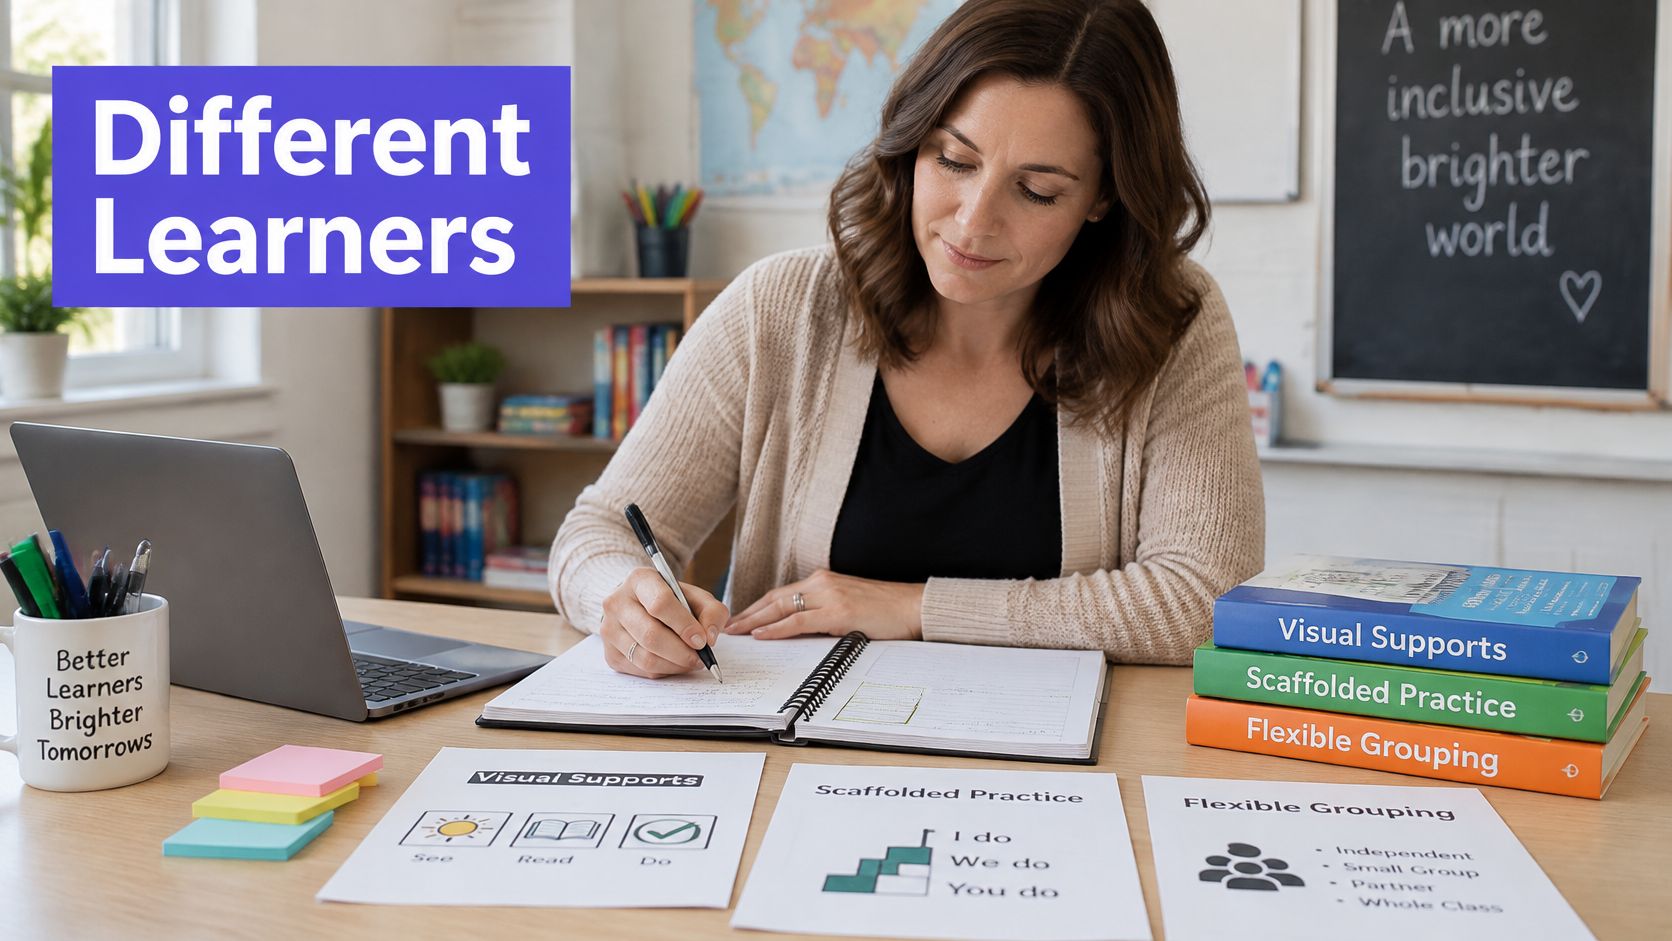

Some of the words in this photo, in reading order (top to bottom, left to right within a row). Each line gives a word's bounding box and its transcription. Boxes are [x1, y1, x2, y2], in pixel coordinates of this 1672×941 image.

[1381, 1, 1415, 54] A
[1439, 9, 1548, 49] more
[1387, 64, 1580, 121] inclusive
[1402, 132, 1590, 212] brighter
[1425, 200, 1555, 258] world
[1278, 617, 1362, 647] Visual
[1371, 621, 1508, 661] Supports
[57, 649, 130, 672] Better
[47, 675, 143, 699] Learners
[1246, 666, 1390, 705] Scaffolded
[1400, 683, 1517, 718] Practice
[50, 704, 143, 737] Brighter
[37, 733, 153, 761] Tomorrows
[1246, 717, 1352, 753] Flexible
[1360, 732, 1499, 778] Grouping
[476, 772, 560, 784] Visual
[567, 773, 699, 787] Supports
[815, 784, 960, 799] Scaffolded
[970, 789, 1084, 803] Practice
[1184, 797, 1301, 813] Flexible
[1310, 803, 1456, 821] Grouping
[954, 831, 960, 842] I
[974, 832, 1012, 844] do
[411, 853, 454, 863] See
[517, 855, 574, 865] Read
[640, 856, 672, 867] Do
[951, 856, 999, 868] We
[1013, 858, 1050, 870] do
[1336, 846, 1474, 862] Independent
[1344, 863, 1403, 874] Small
[1411, 866, 1480, 880] Group
[948, 883, 1005, 897] You
[1019, 886, 1059, 898] do
[1351, 879, 1435, 893] Partner
[1358, 897, 1433, 910] Whole
[1441, 900, 1504, 914] Class
